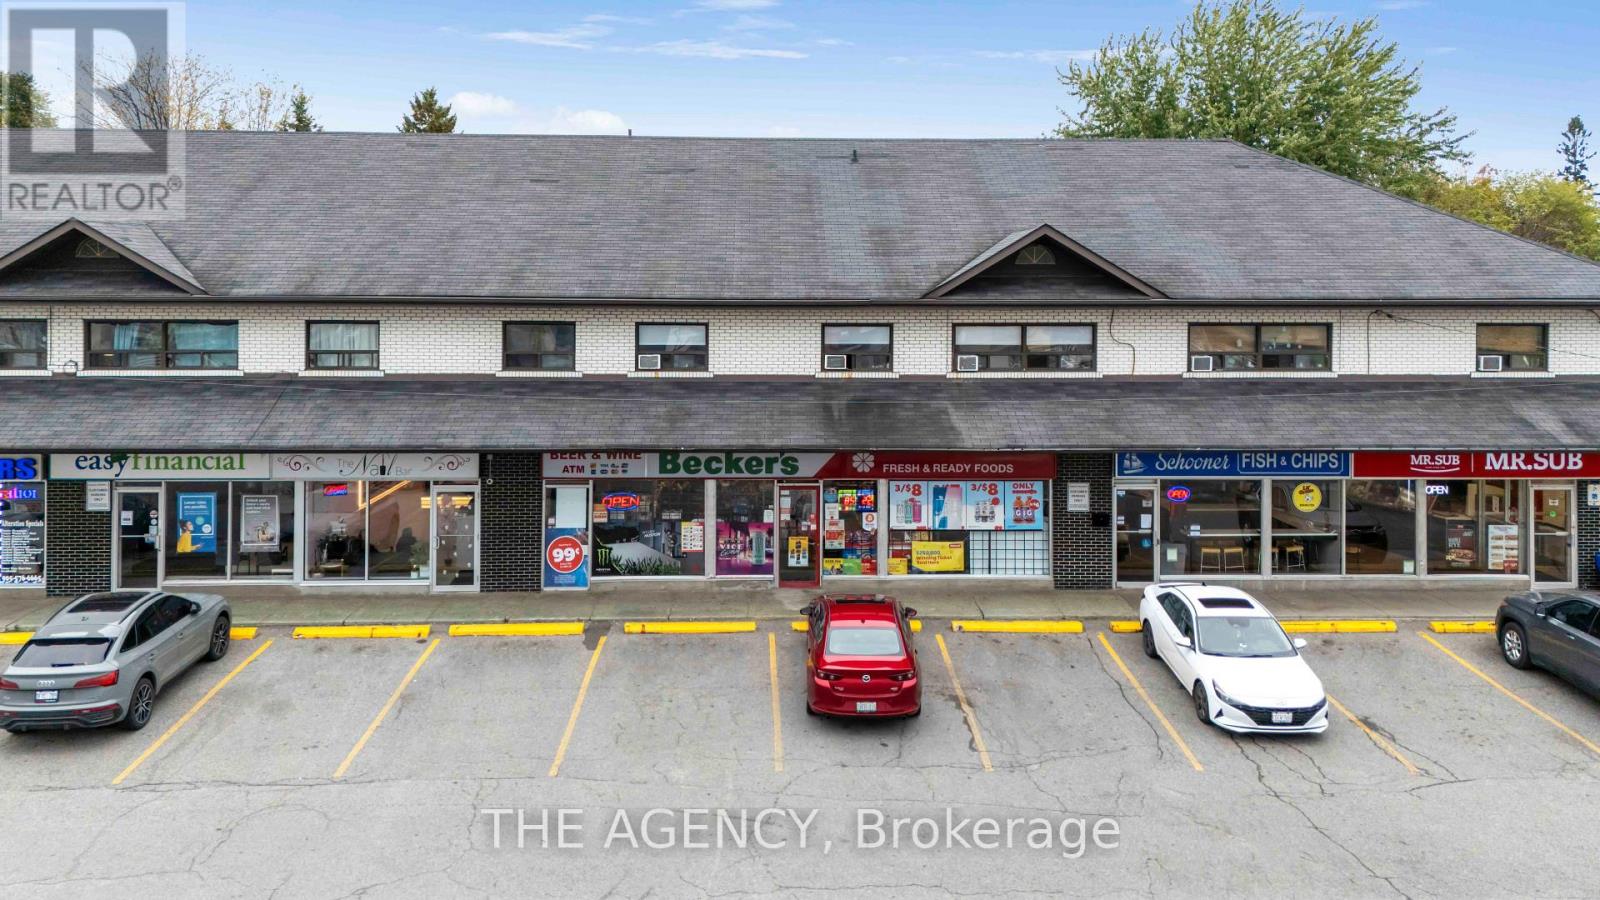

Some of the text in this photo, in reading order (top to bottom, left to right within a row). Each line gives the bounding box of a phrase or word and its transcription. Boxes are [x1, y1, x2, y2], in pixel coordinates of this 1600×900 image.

[550, 451, 642, 460] BEER & WINE
[1410, 455, 1460, 465] MR.SUB
[659, 451, 800, 475] Becker's
[1155, 453, 1339, 471] Schooner FISH & CHIPS
[1485, 453, 1583, 471] MR.SUB
[562, 465, 585, 474] ATM
[883, 464, 1014, 473] FRESH & READY FOODS
[1425, 486, 1449, 495] OPEN
[602, 495, 640, 508] OPEN
